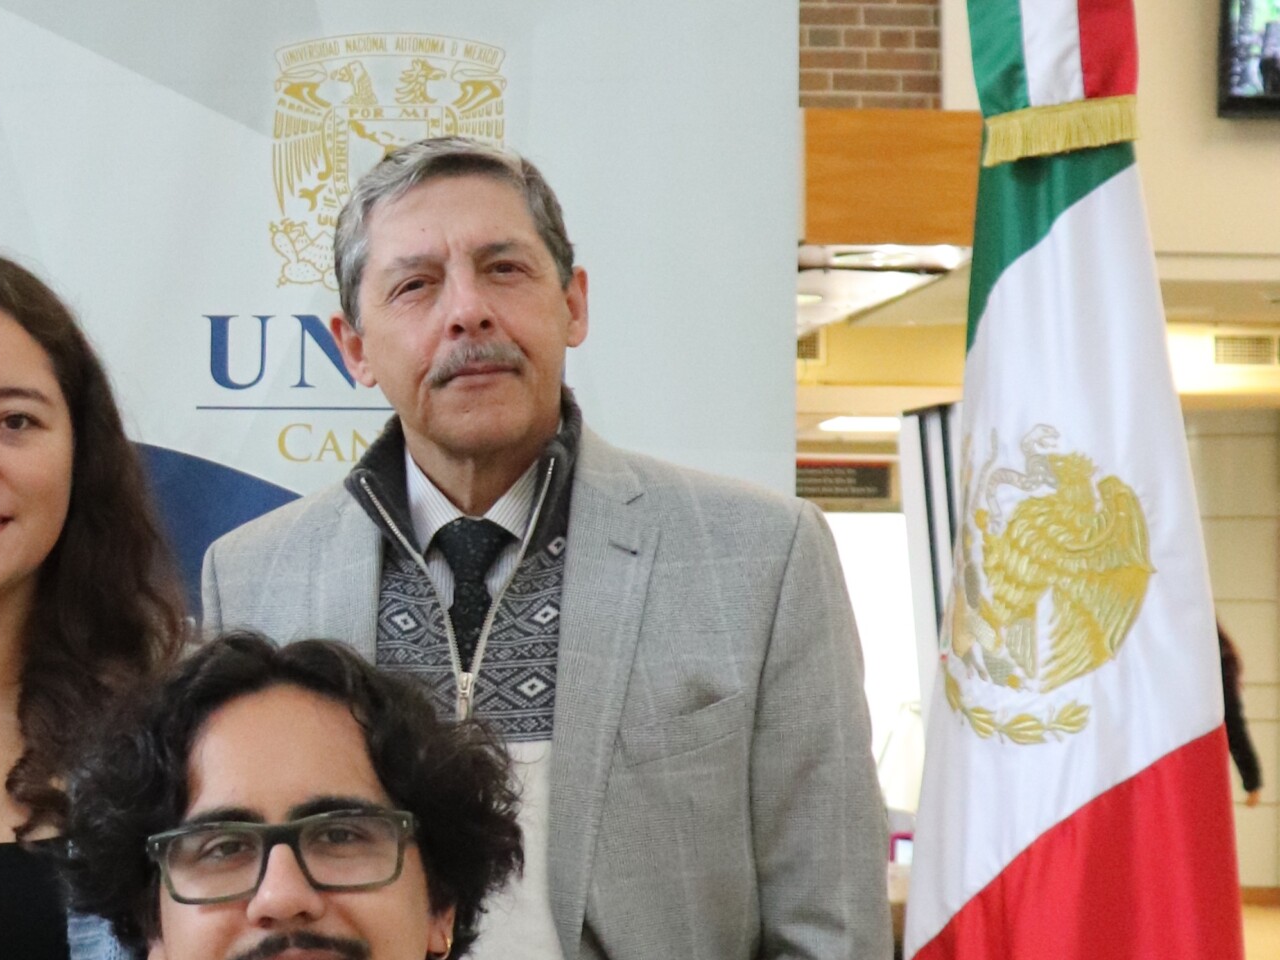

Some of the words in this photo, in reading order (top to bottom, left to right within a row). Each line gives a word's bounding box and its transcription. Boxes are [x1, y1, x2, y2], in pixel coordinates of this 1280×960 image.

[348, 107, 384, 118] POR
[400, 107, 429, 118] MI
[201, 313, 357, 392] UN
[277, 422, 372, 464] CAN
